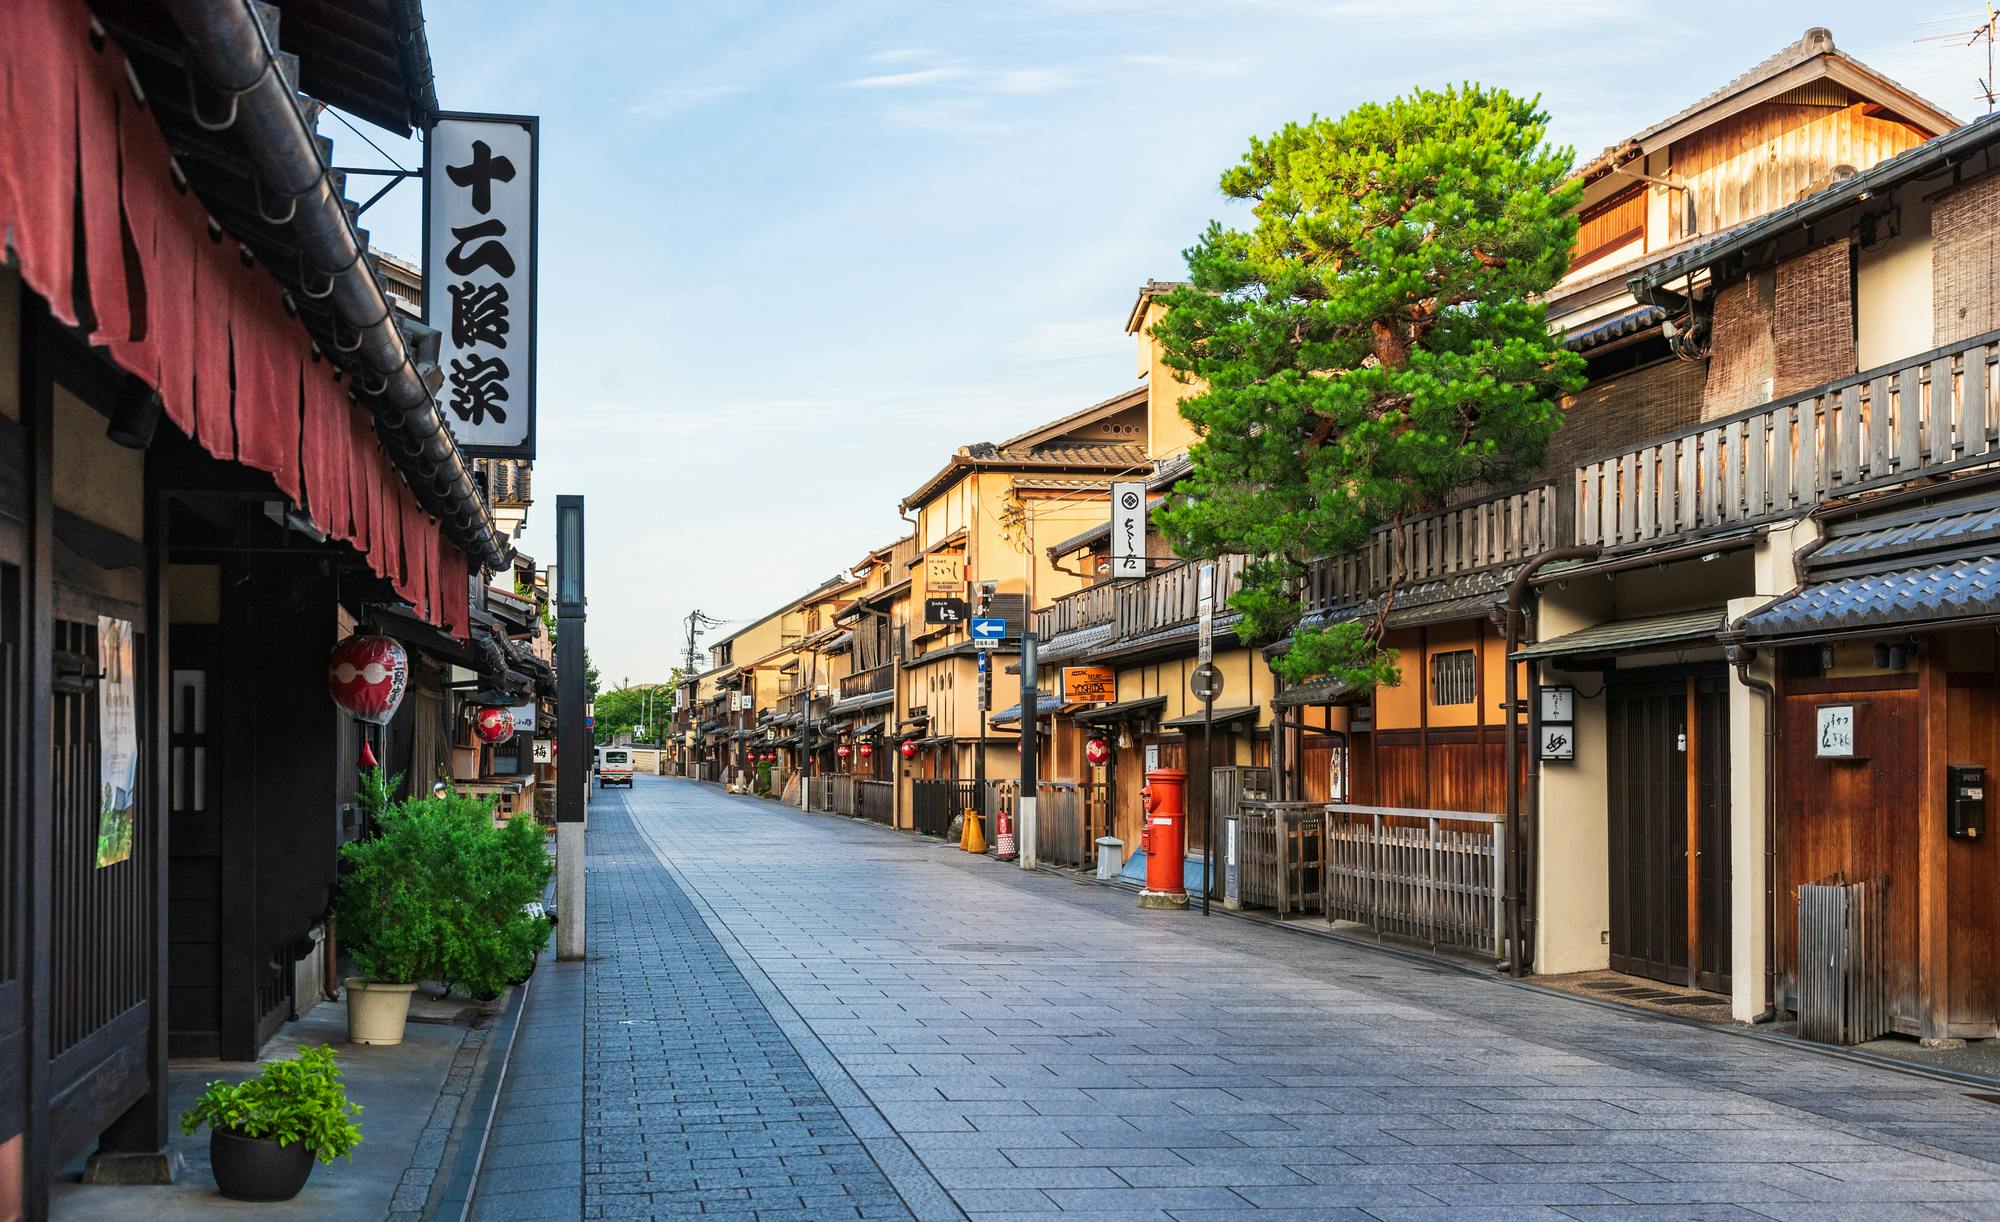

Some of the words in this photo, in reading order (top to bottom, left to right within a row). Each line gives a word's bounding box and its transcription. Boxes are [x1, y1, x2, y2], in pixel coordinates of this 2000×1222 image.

[446, 139, 516, 426] 十二段家
[1072, 683, 1106, 694] YOSHIDA
[534, 745, 547, 758] 梅
